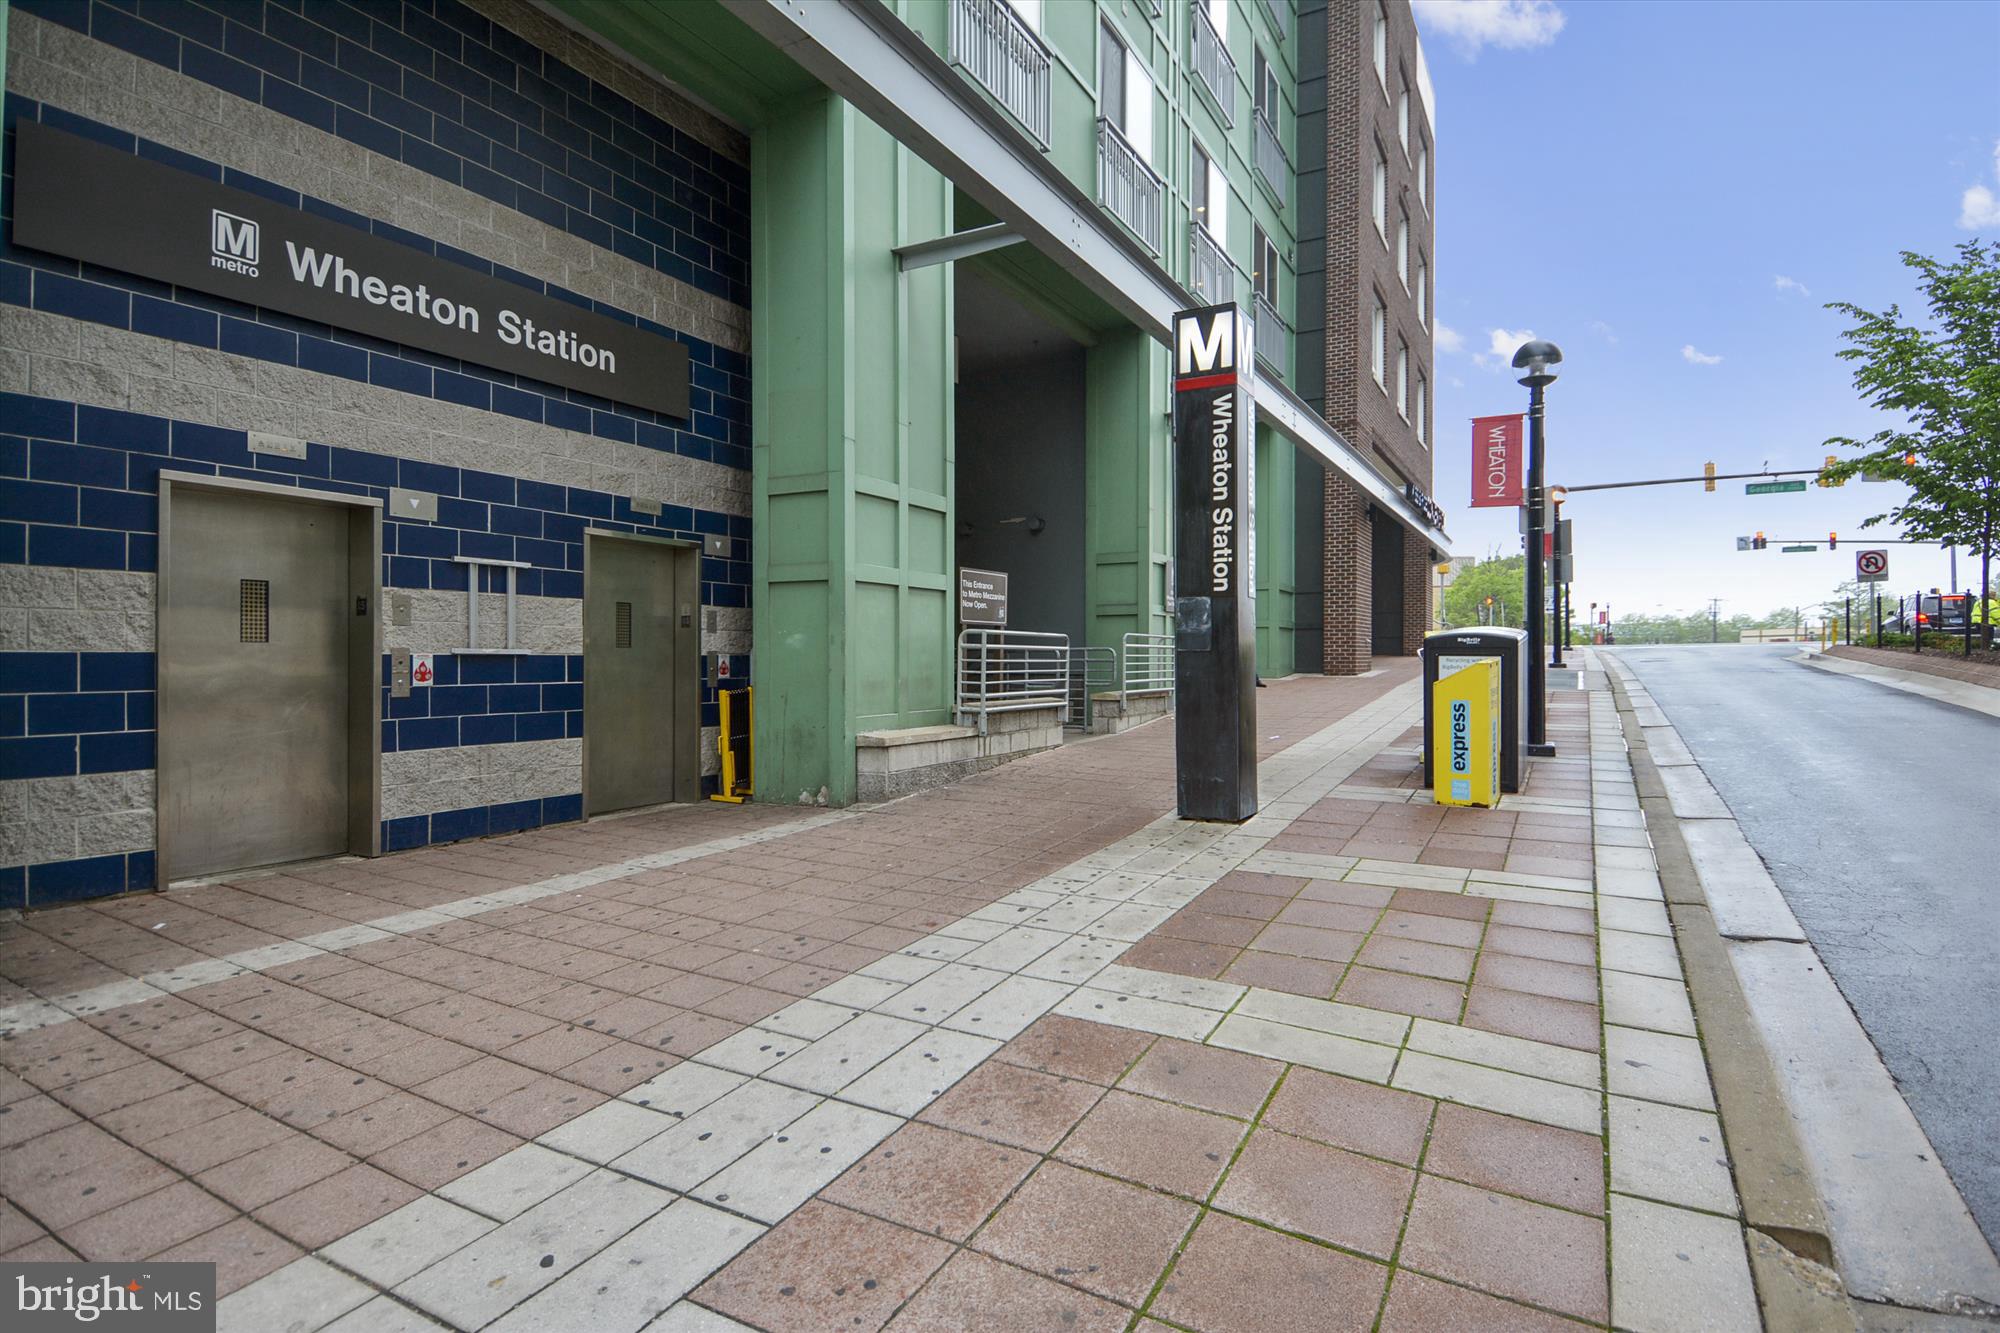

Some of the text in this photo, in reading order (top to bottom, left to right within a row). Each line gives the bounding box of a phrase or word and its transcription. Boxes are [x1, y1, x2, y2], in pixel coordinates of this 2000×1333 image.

[211, 256, 259, 278] metro
[217, 215, 255, 259] M
[285, 240, 616, 374] Wheaton Station
[1180, 311, 1233, 374] M
[1237, 313, 1253, 379] M
[1211, 392, 1233, 592] Wheaton Station
[1488, 425, 1506, 498] WHEATON
[962, 580, 993, 590] This Entrance
[962, 600, 973, 608] Now
[969, 590, 982, 599] Metro
[983, 592, 1005, 601] Mezzanine
[1453, 702, 1469, 771] express
